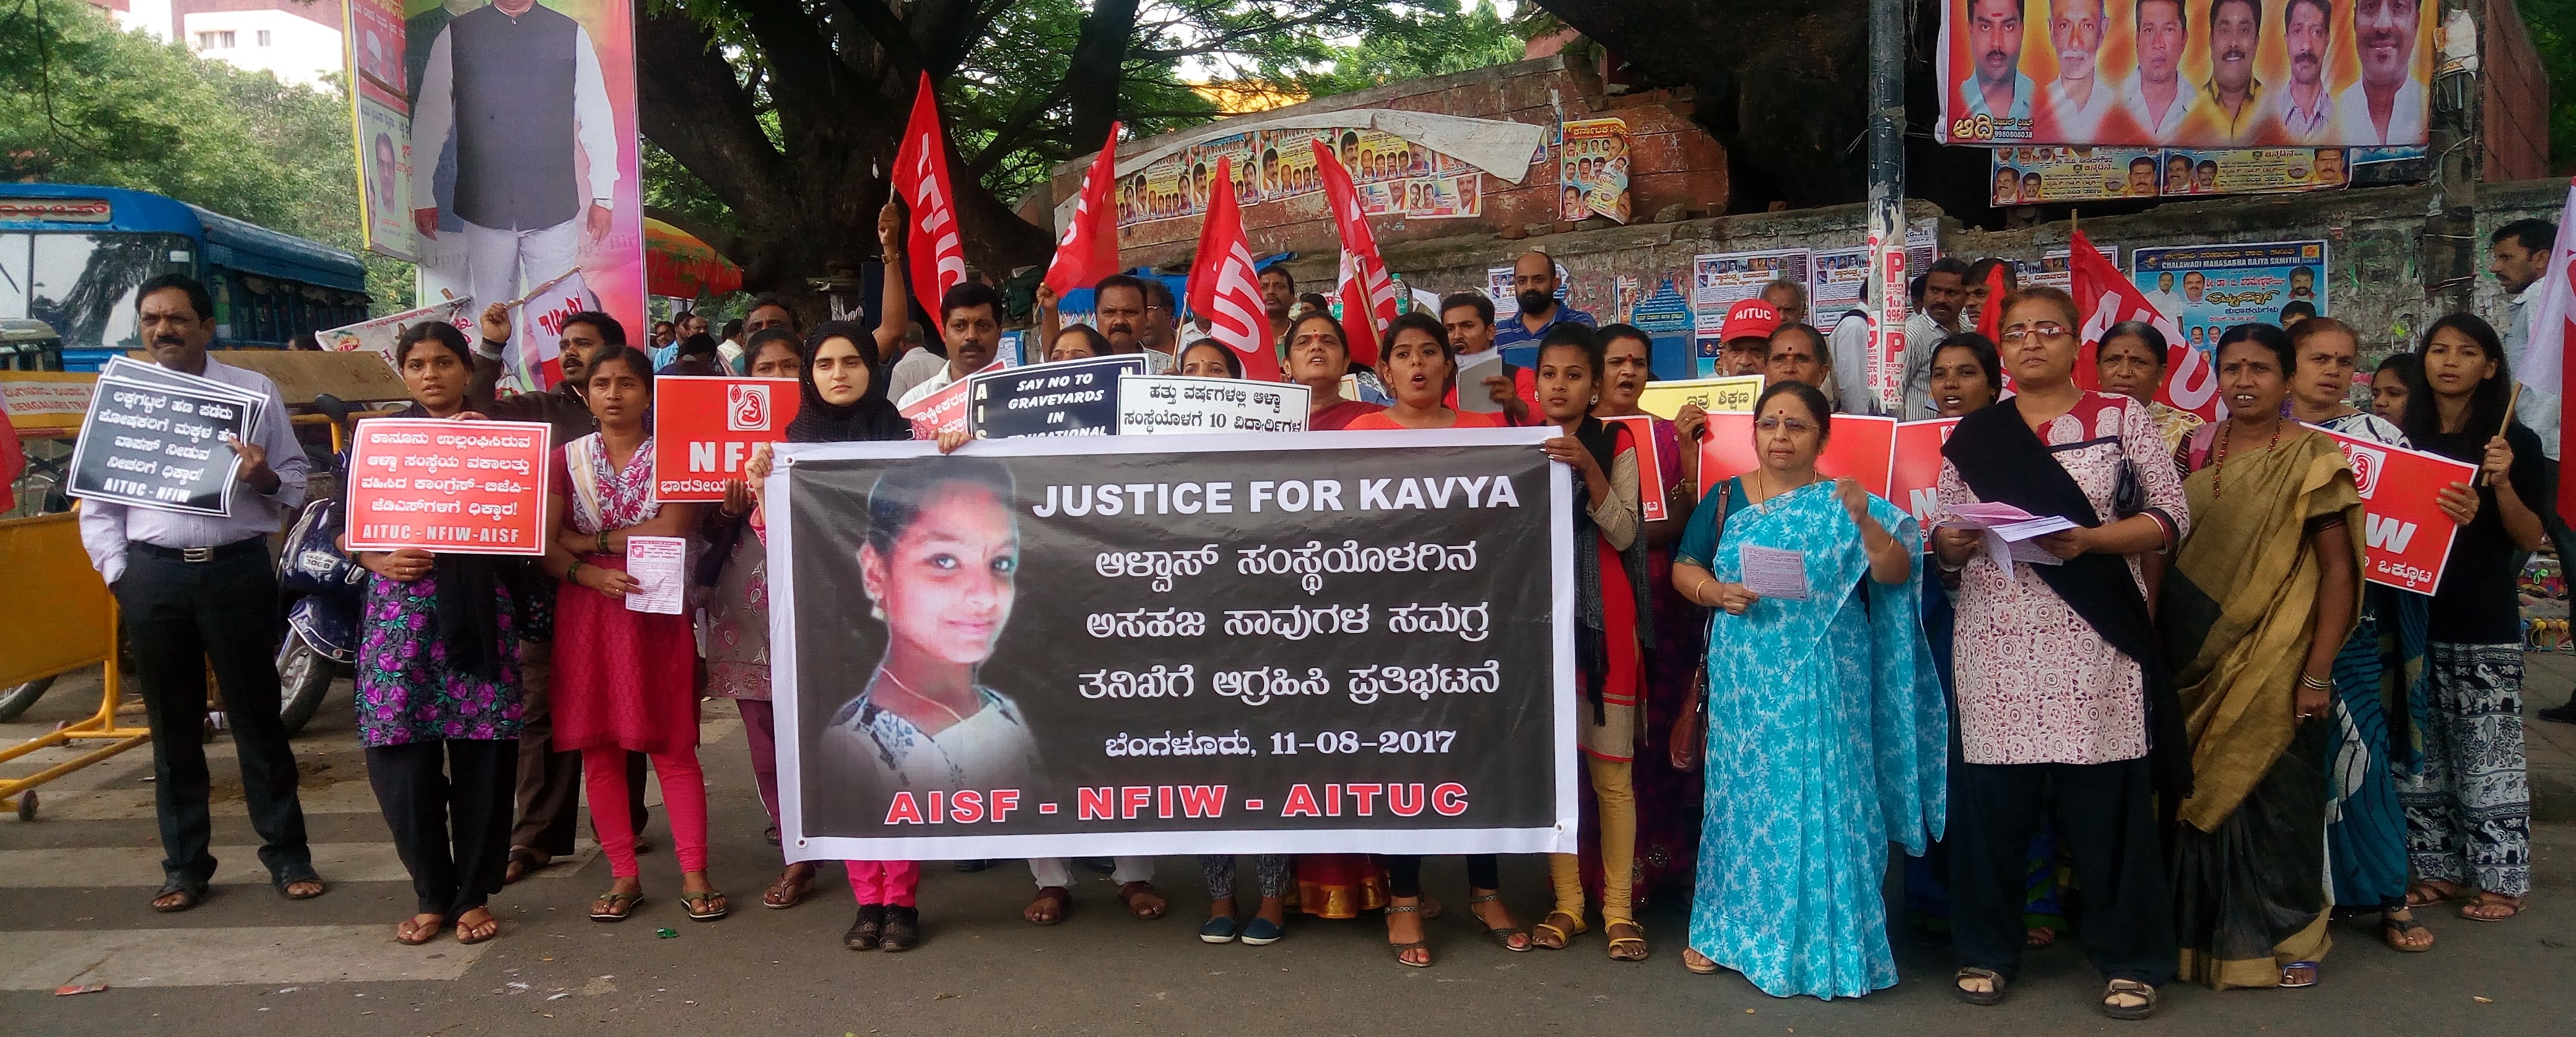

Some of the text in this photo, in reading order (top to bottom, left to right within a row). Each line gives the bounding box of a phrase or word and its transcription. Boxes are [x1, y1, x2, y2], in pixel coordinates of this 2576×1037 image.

[1953, 114, 1994, 139] ಆದಿ
[2162, 260, 2202, 269] CHALAWADI
[1734, 308, 1772, 321] AITUC
[1016, 373, 1093, 391] SAY NO TO
[1008, 390, 1105, 409] GRAVEYARDS
[1149, 383, 1177, 405] ಹತ್ತು
[1184, 384, 1247, 409] ವರ್ಷಗಳಲ್ಲಿ
[1718, 390, 1749, 410] ಶಿಕ್ಷಣ
[171, 399, 193, 414] ಹಣ
[1046, 411, 1065, 424] IN
[1209, 412, 1227, 428] 10
[173, 422, 213, 443] ಮಕ್ಕಳ
[370, 430, 429, 445] ಕಾನೂನು
[114, 433, 212, 461] ವಾಪಸ್ ನೀಡುವ
[107, 455, 158, 475] ನೀಚರಿಗೆ
[103, 477, 147, 496] AITUC
[155, 487, 191, 503] NFIW
[360, 475, 407, 489] ವಹಿಸಿದ
[660, 477, 726, 495] ಭಾರತೀಯ
[1032, 475, 1520, 518] JUSTICE FOR KAVYA
[362, 524, 412, 540] AITUC
[1095, 539, 1478, 596] ಆಳ್ವಾಸ್ ಸಂಸ್ಥೆಯೊಳಗಿನ
[2377, 560, 2433, 588] ಒಕ್ಕೂಟ
[1086, 601, 1490, 641] ಅಸಹಜ ಸಾವುಗಳ ಸಮಗ್ರ
[1078, 659, 1500, 705] ತನಿಖೆಗೆ ಆಗ್ರಹಿಸಿ ಪ್ರತಿಭಟನೆ
[1105, 728, 1456, 758] ಬೆಂಗಳೂರು, 11-08-2017
[884, 788, 1020, 825] AISF
[1076, 784, 1228, 822] NFIW
[1280, 781, 1470, 819] AITUC
